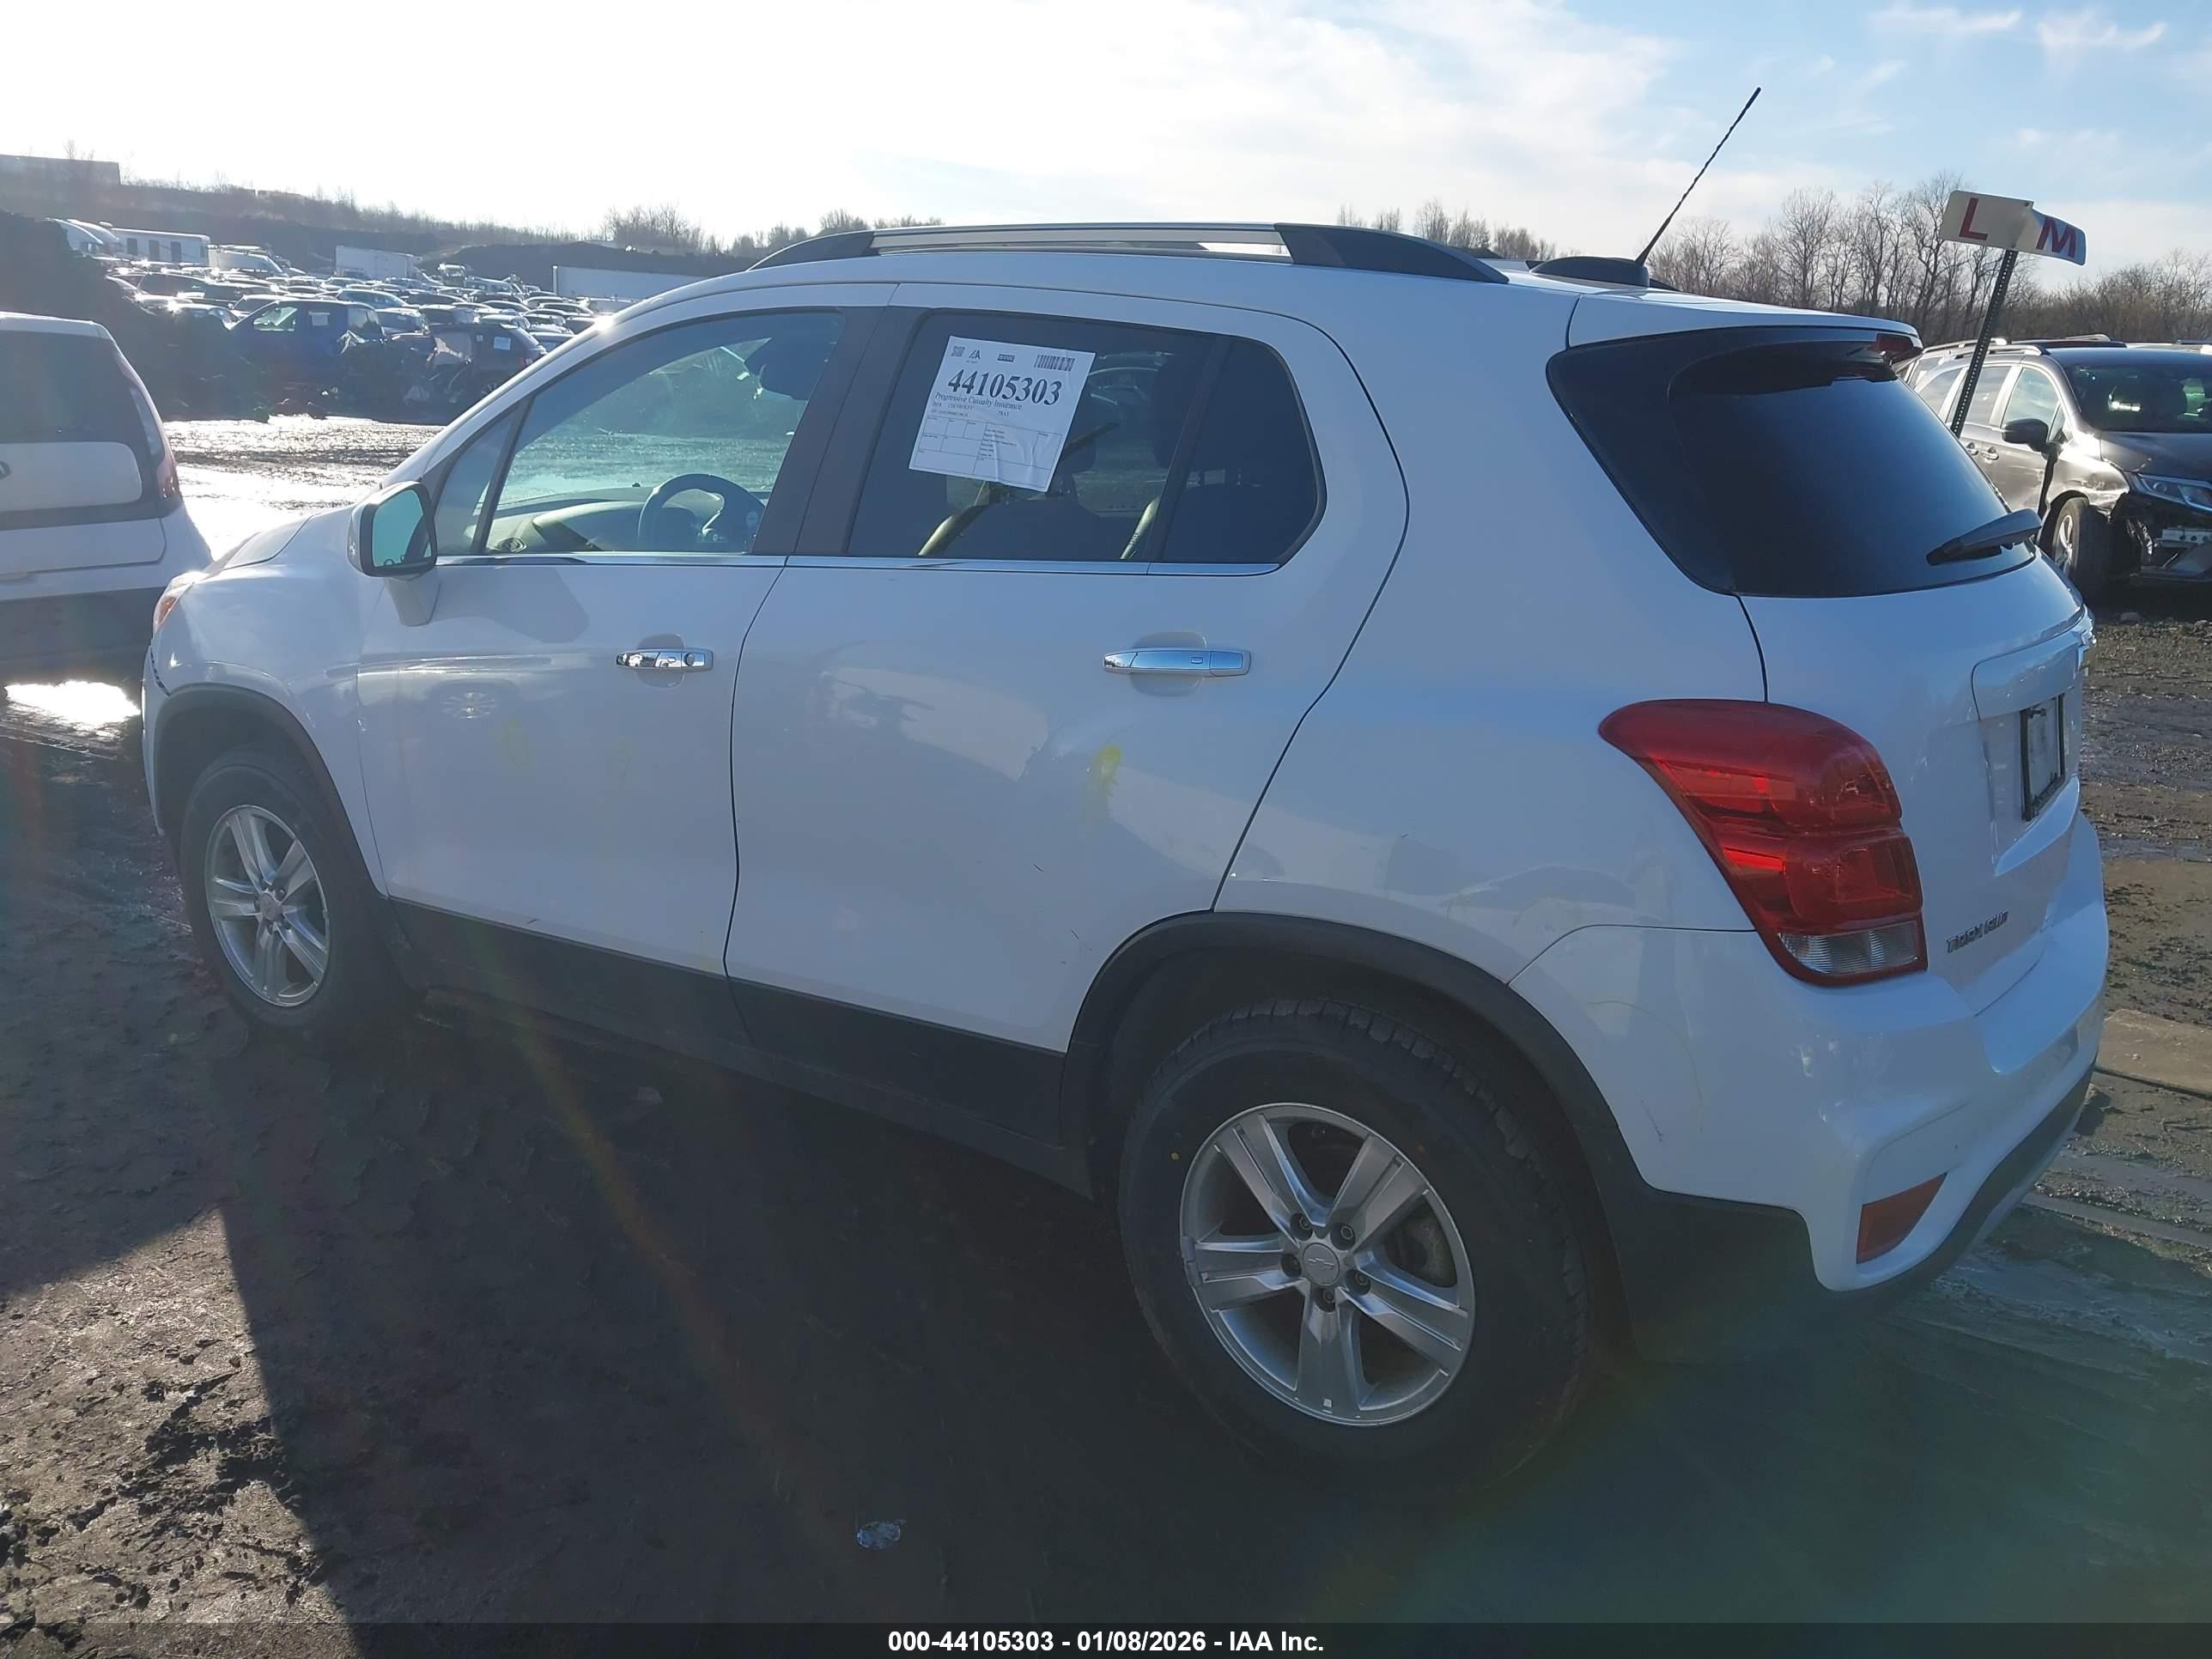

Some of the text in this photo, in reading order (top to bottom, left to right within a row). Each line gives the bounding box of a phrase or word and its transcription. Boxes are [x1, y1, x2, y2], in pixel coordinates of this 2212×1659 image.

[1959, 198, 1989, 240] L
[2035, 216, 2076, 258] M
[935, 392, 1023, 410] Progressive Casualty Insurance
[948, 369, 1062, 405] 44105303
